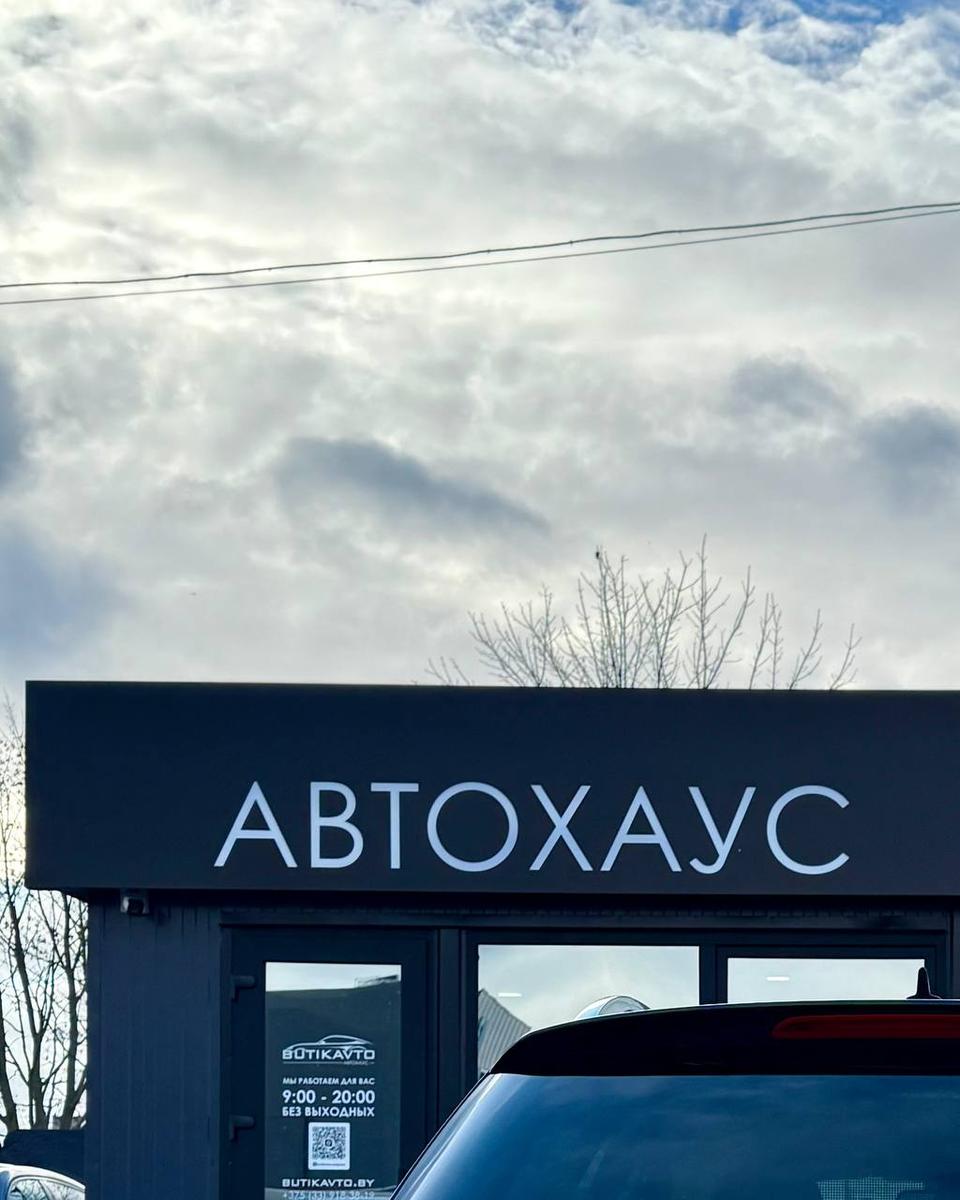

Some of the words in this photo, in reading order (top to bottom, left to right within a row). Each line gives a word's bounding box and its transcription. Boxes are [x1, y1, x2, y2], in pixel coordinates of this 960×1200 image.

[213, 780, 850, 876] АВТОХАУС
[282, 1049, 375, 1060] BUTIKAVTO
[298, 1077, 339, 1085] РАБОТАЕМ
[340, 1077, 357, 1086] ДЛЯ
[358, 1077, 375, 1085] ВАС
[282, 1089, 316, 1104] 9:00
[331, 1089, 375, 1104] 20:00
[282, 1106, 302, 1117] БЕЗ
[305, 1106, 375, 1118] ВЫХОДНЫХ
[282, 1178, 375, 1187] BUTIKAVTO.BY
